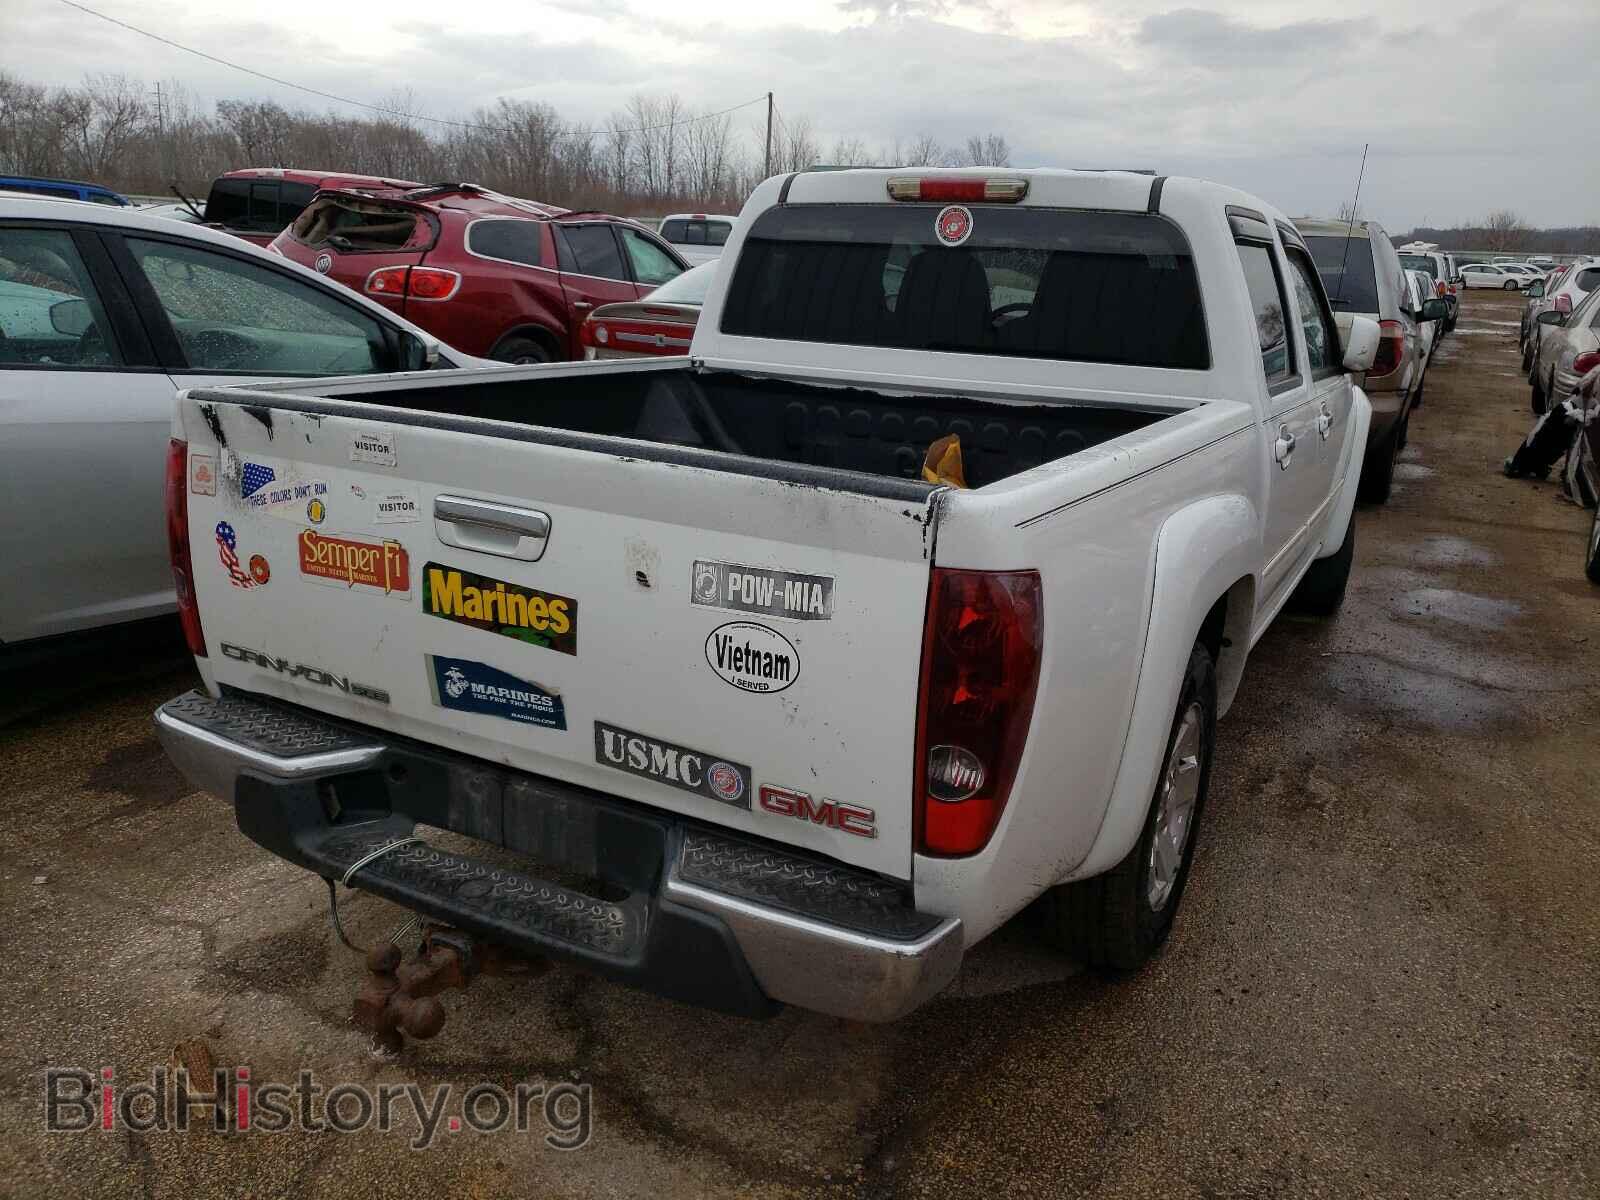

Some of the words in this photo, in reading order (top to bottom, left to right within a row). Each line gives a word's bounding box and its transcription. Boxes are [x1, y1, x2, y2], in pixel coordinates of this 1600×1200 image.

[354, 441, 390, 454] VISITOR
[250, 493, 267, 507] THESE
[270, 489, 292, 504] COLORS
[294, 484, 311, 499] DON'T
[314, 482, 327, 496] RUN
[378, 501, 416, 512] VISITOR
[303, 530, 380, 586] Semper
[383, 540, 400, 594] Fi
[429, 568, 570, 634] Marines
[728, 572, 824, 615] POW-MIA
[220, 642, 350, 694] CANYON
[715, 632, 791, 682] Vietnam
[470, 682, 553, 707] MARINES
[472, 692, 488, 701] THE
[510, 699, 526, 708] THE
[737, 678, 769, 691] SERVED
[601, 729, 702, 787] USMC
[759, 783, 876, 839] GMC
